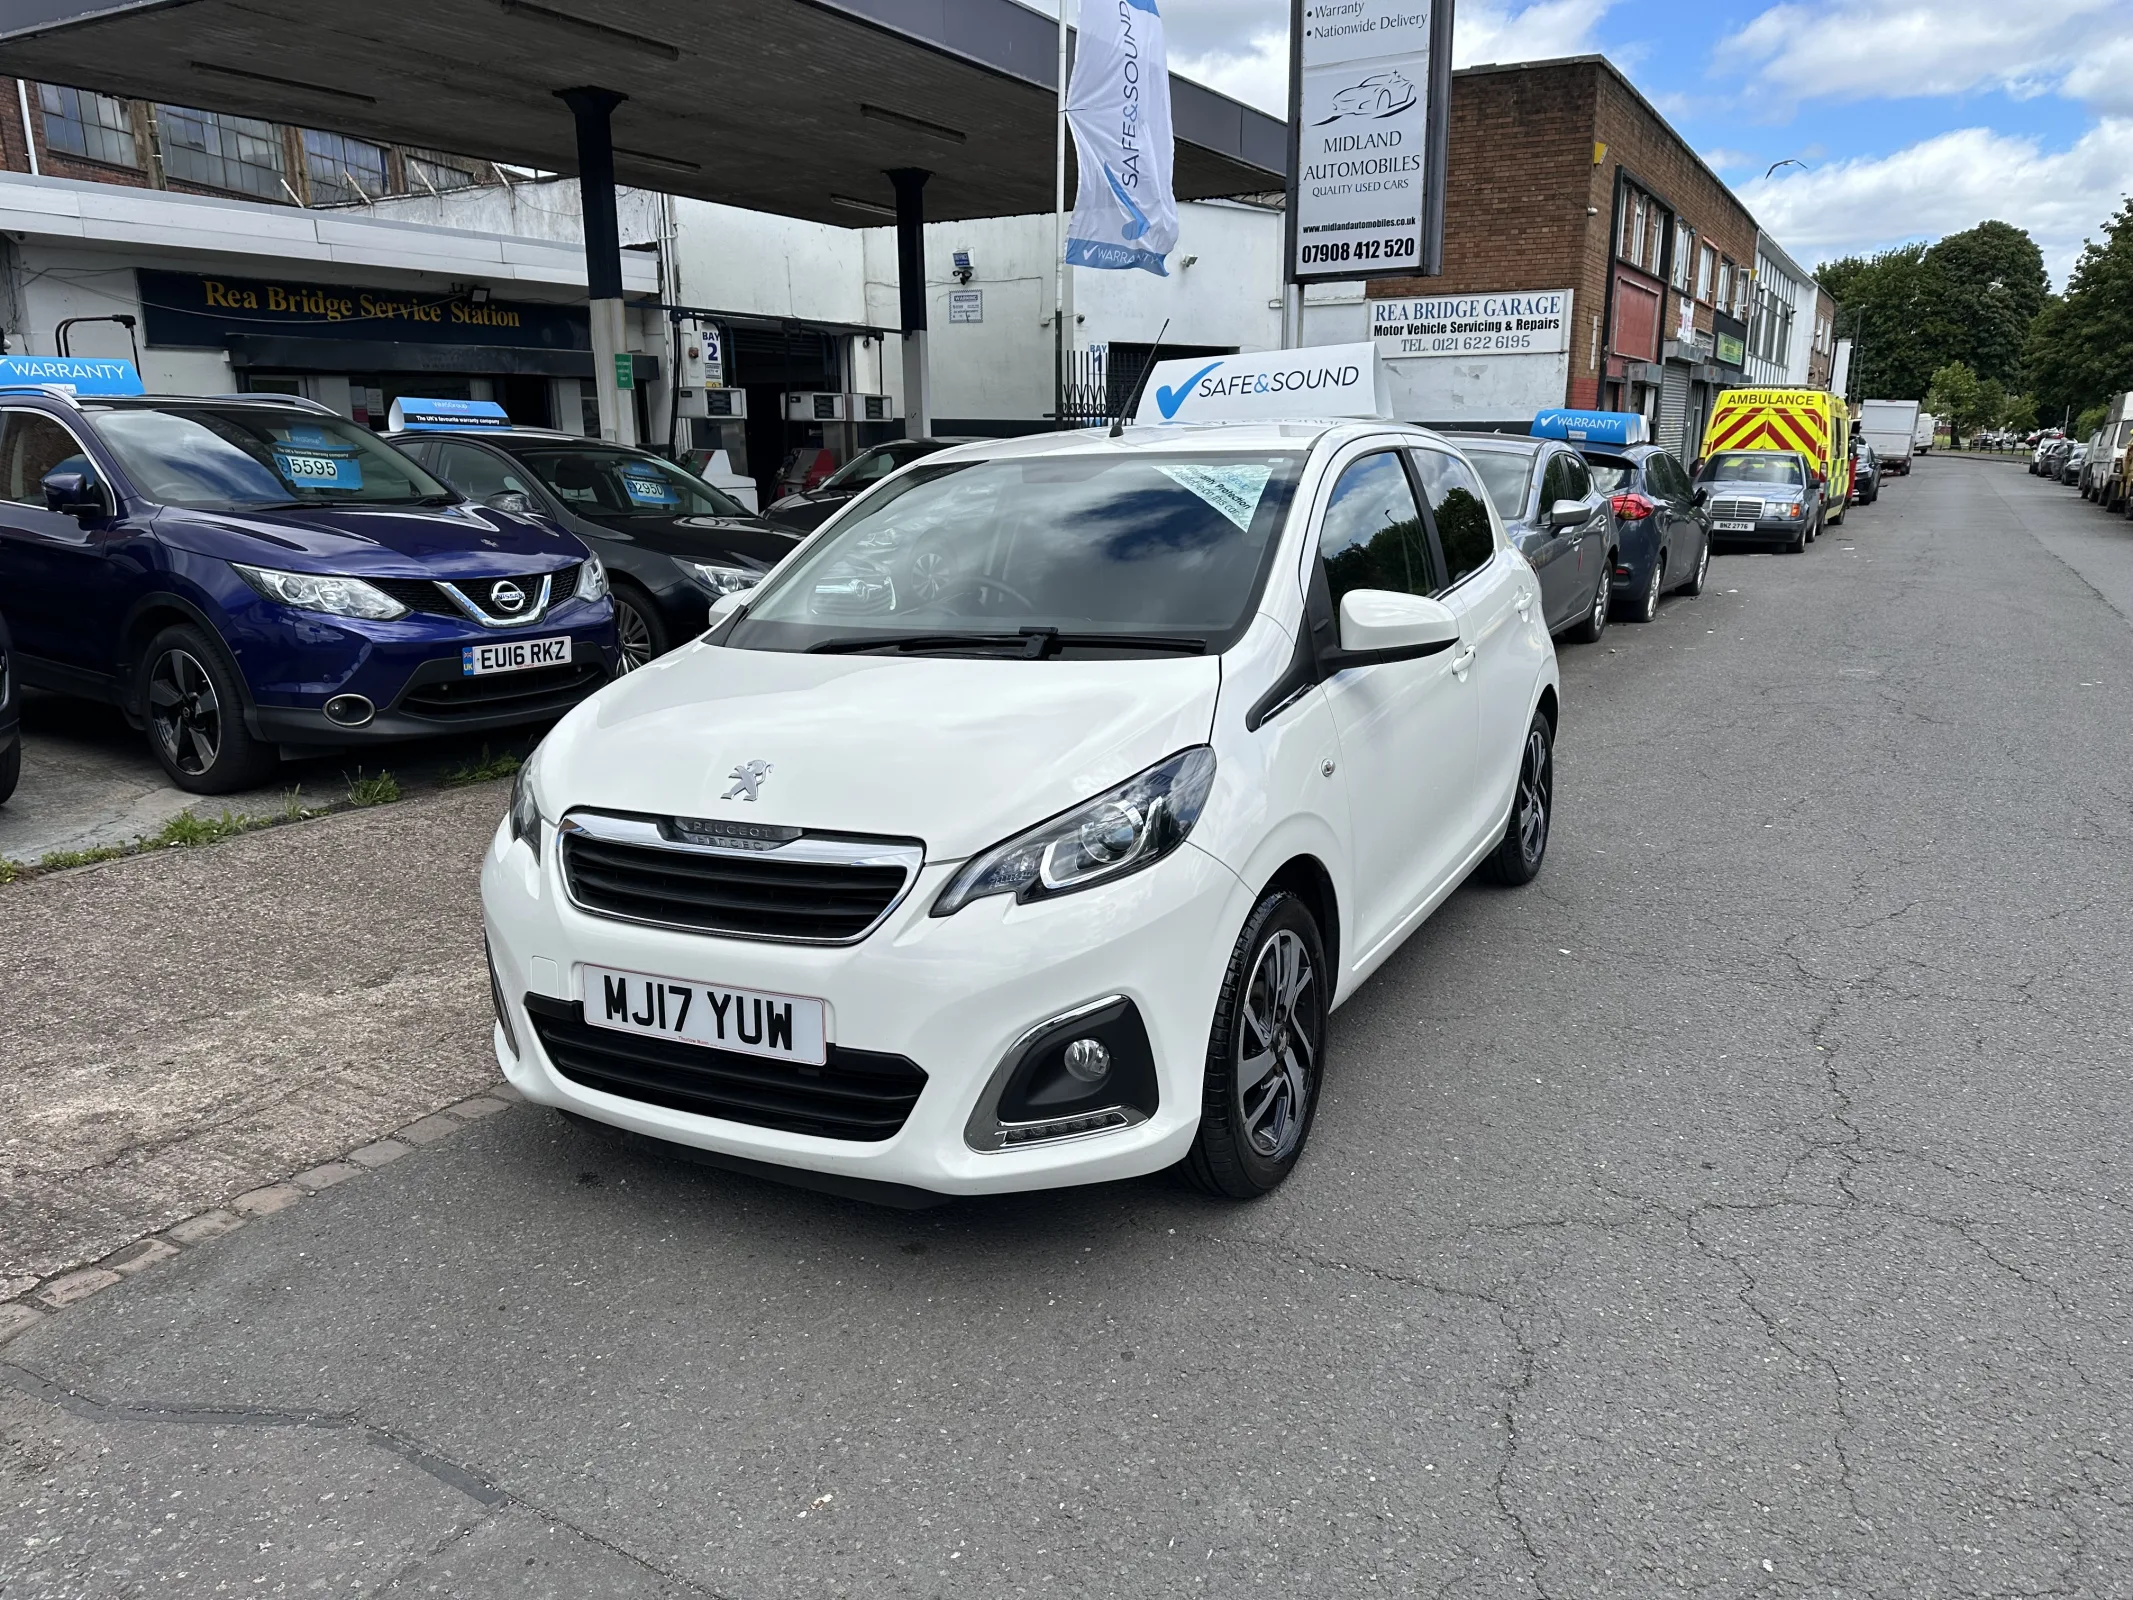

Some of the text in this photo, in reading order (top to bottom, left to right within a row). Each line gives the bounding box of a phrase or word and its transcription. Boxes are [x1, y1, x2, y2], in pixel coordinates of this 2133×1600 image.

[1315, 1, 1364, 18] Warranty
[1315, 13, 1428, 39] Nationwide Delivery
[1119, 0, 1140, 188] SAFE&SOUND
[1324, 130, 1402, 153] MIDLAND
[1303, 155, 1420, 180] AUTOMOBILES
[1312, 179, 1409, 197] QUALITY USED CARS
[1303, 216, 1416, 233] www.midlandautomobiles.co.uk
[1302, 237, 1415, 263] 07908 412 520
[203, 280, 521, 327] Rea Bridge Service Station
[1375, 295, 1561, 321] REA BRIDGE GARAGE
[1374, 317, 1560, 336] Motor Vehicle Servicing & Repairs
[702, 331, 720, 341] BAY
[1401, 334, 1531, 351] TEL. 0121 622 6195
[707, 342, 718, 361] 2
[1090, 344, 1107, 353] BAY
[9, 361, 124, 379] WARRANTY
[1199, 365, 1359, 398] SAFE&SOUND
[1727, 394, 1815, 405] AMBULANCE
[1556, 415, 1621, 430] WARRANTY
[1211, 493, 1226, 507] this
[1216, 482, 1251, 510] Protection
[497, 592, 523, 600] NISSAN
[481, 640, 565, 669] EU16 RKZ
[464, 663, 472, 671] UK
[693, 821, 770, 838] PEUGEOT
[604, 975, 793, 1051] MJ17 YUW
